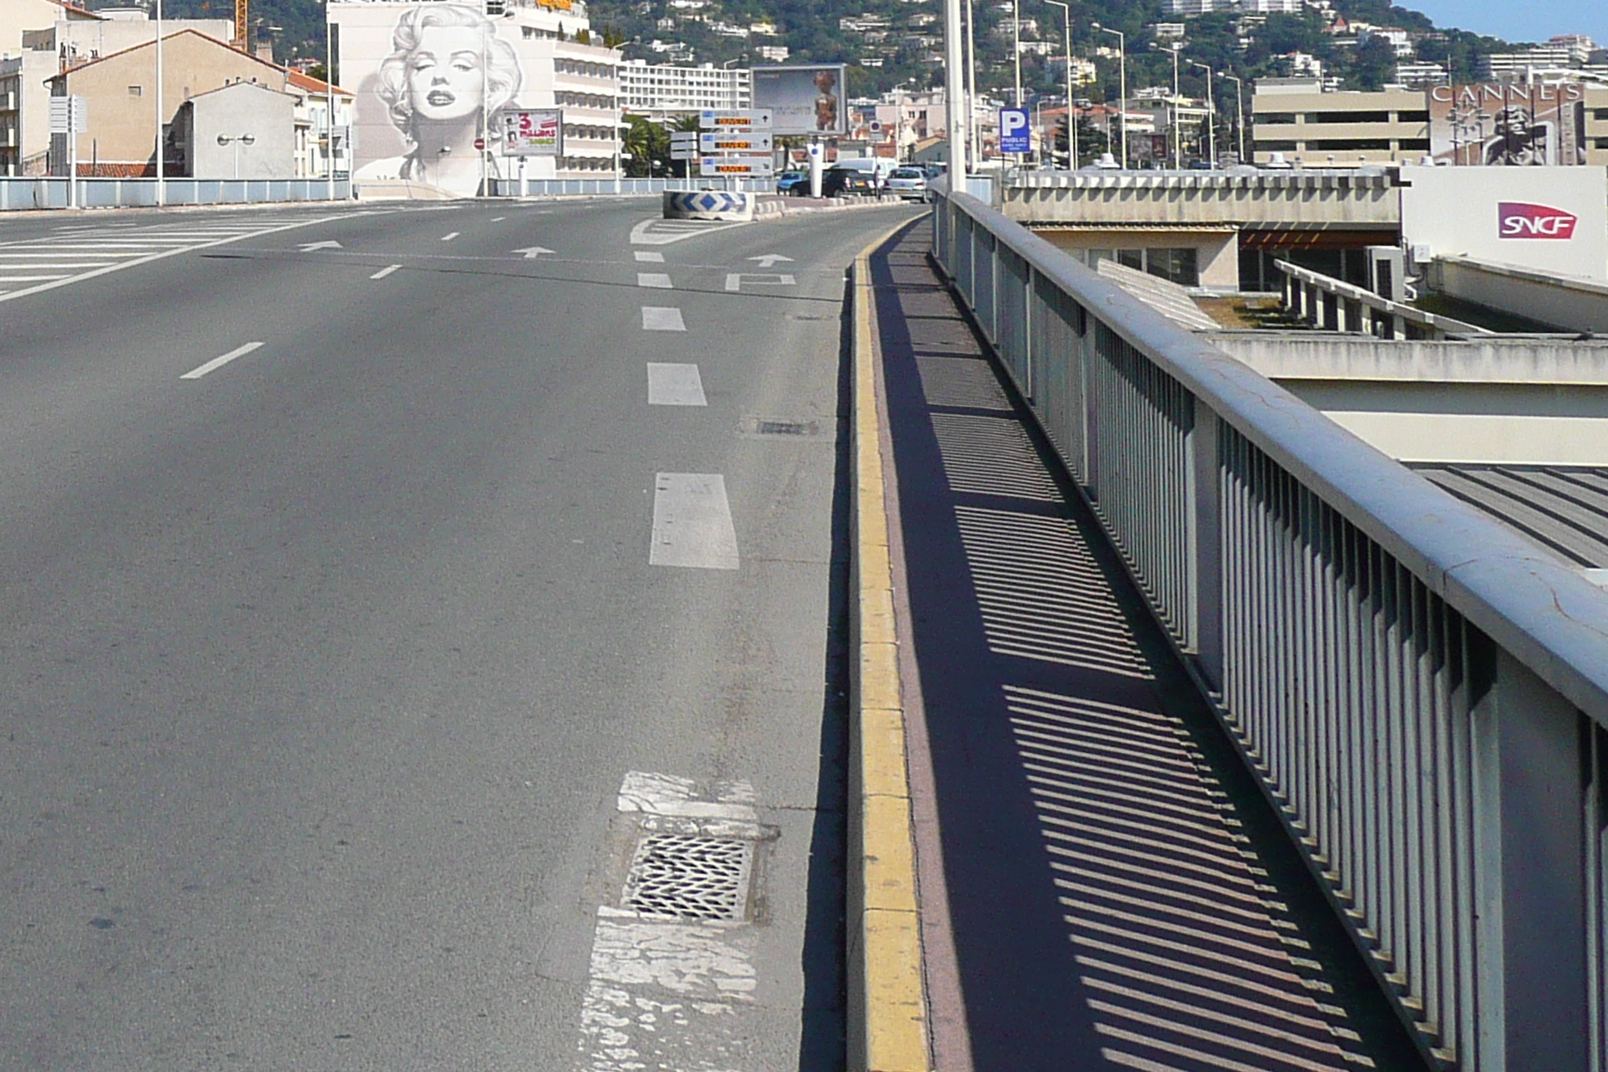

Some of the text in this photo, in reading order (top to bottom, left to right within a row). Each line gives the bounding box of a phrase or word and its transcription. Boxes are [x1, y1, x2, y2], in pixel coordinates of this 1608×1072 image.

[1432, 85, 1580, 102] CANNES
[518, 112, 532, 129] 3
[1002, 111, 1025, 136] P
[1501, 215, 1574, 234] SNCF
